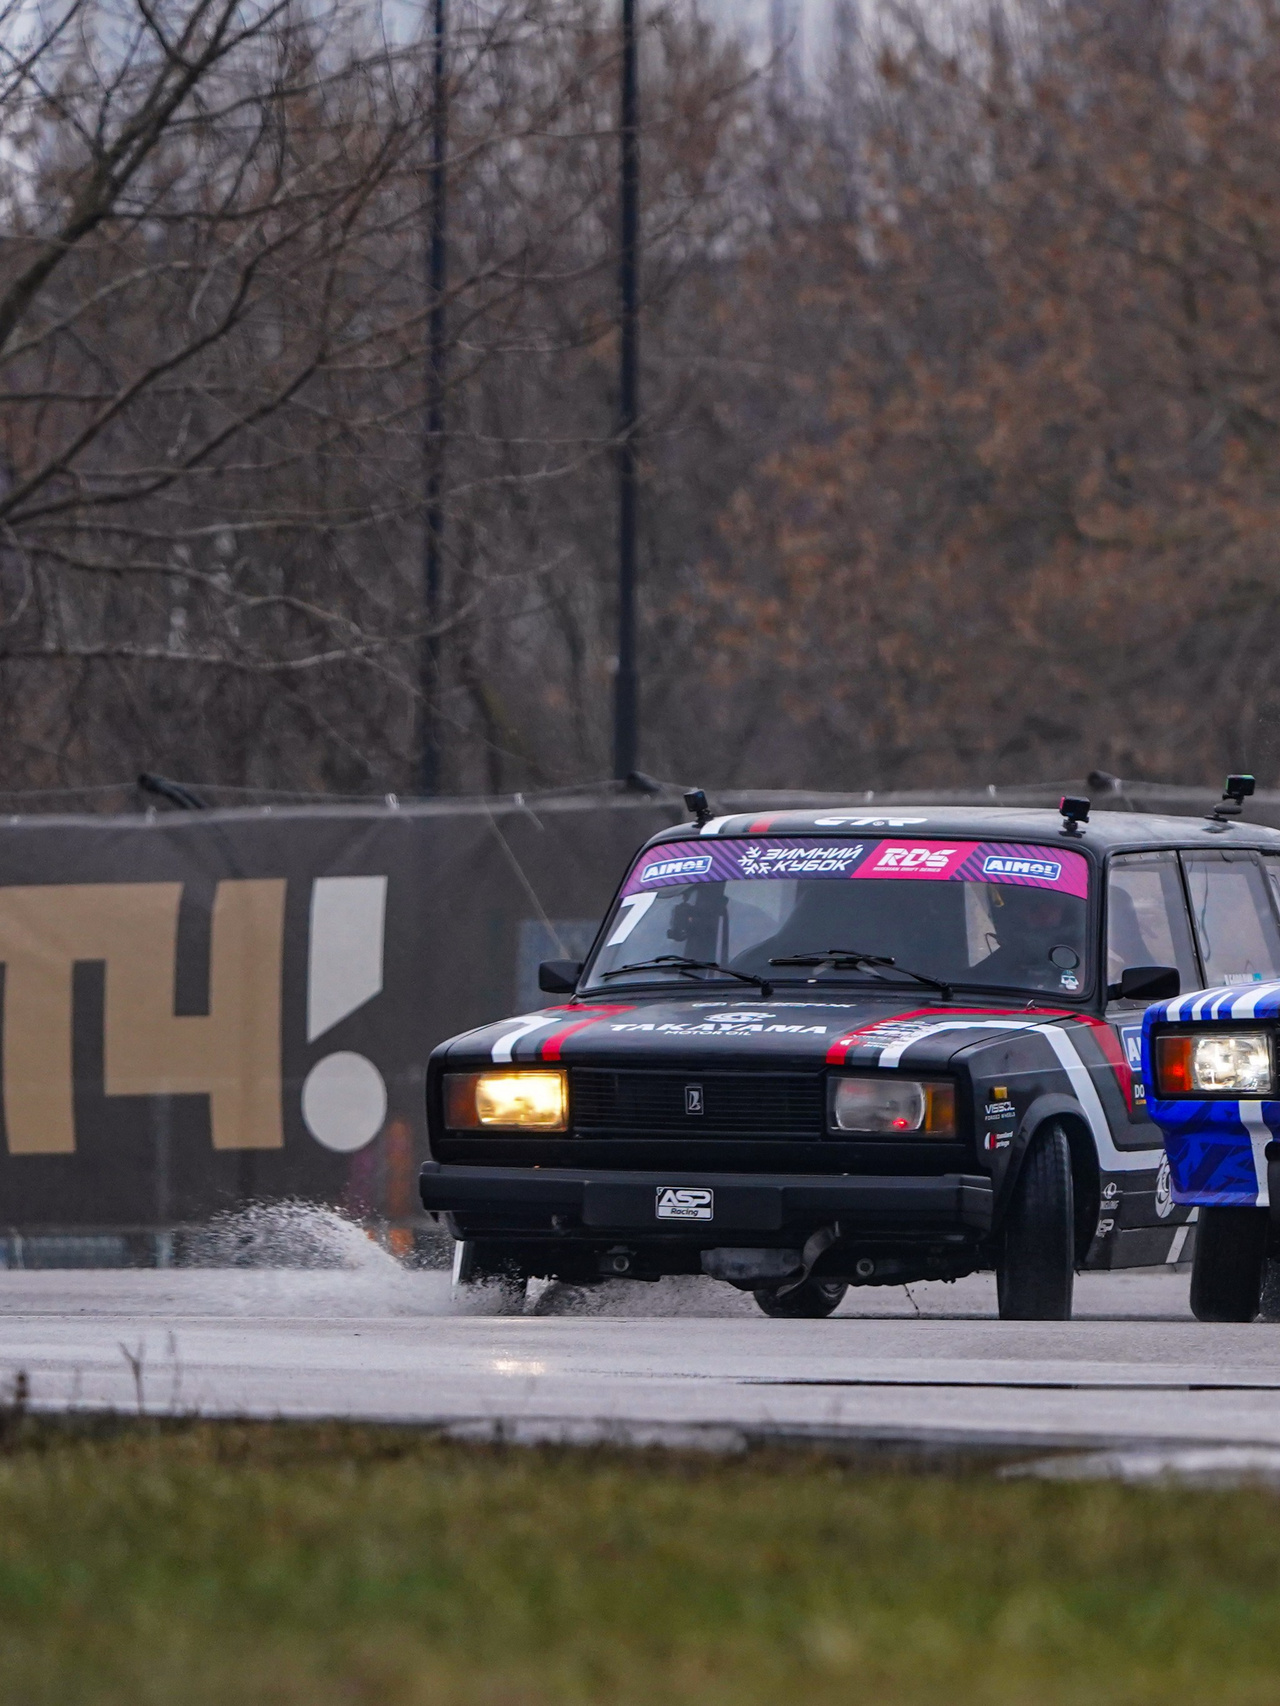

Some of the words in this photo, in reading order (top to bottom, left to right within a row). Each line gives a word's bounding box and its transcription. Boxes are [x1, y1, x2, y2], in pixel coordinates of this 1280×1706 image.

[761, 844, 864, 860] ЗИМНИЙ
[877, 848, 958, 867] RDS
[643, 858, 708, 880] AIMOL
[772, 859, 853, 872] КУБОК
[986, 859, 1058, 876] AIMOL
[606, 892, 659, 947] 7
[611, 1022, 827, 1034] TAKAYAMA
[658, 1189, 711, 1208] ASP
[670, 1207, 699, 1217] Racing
